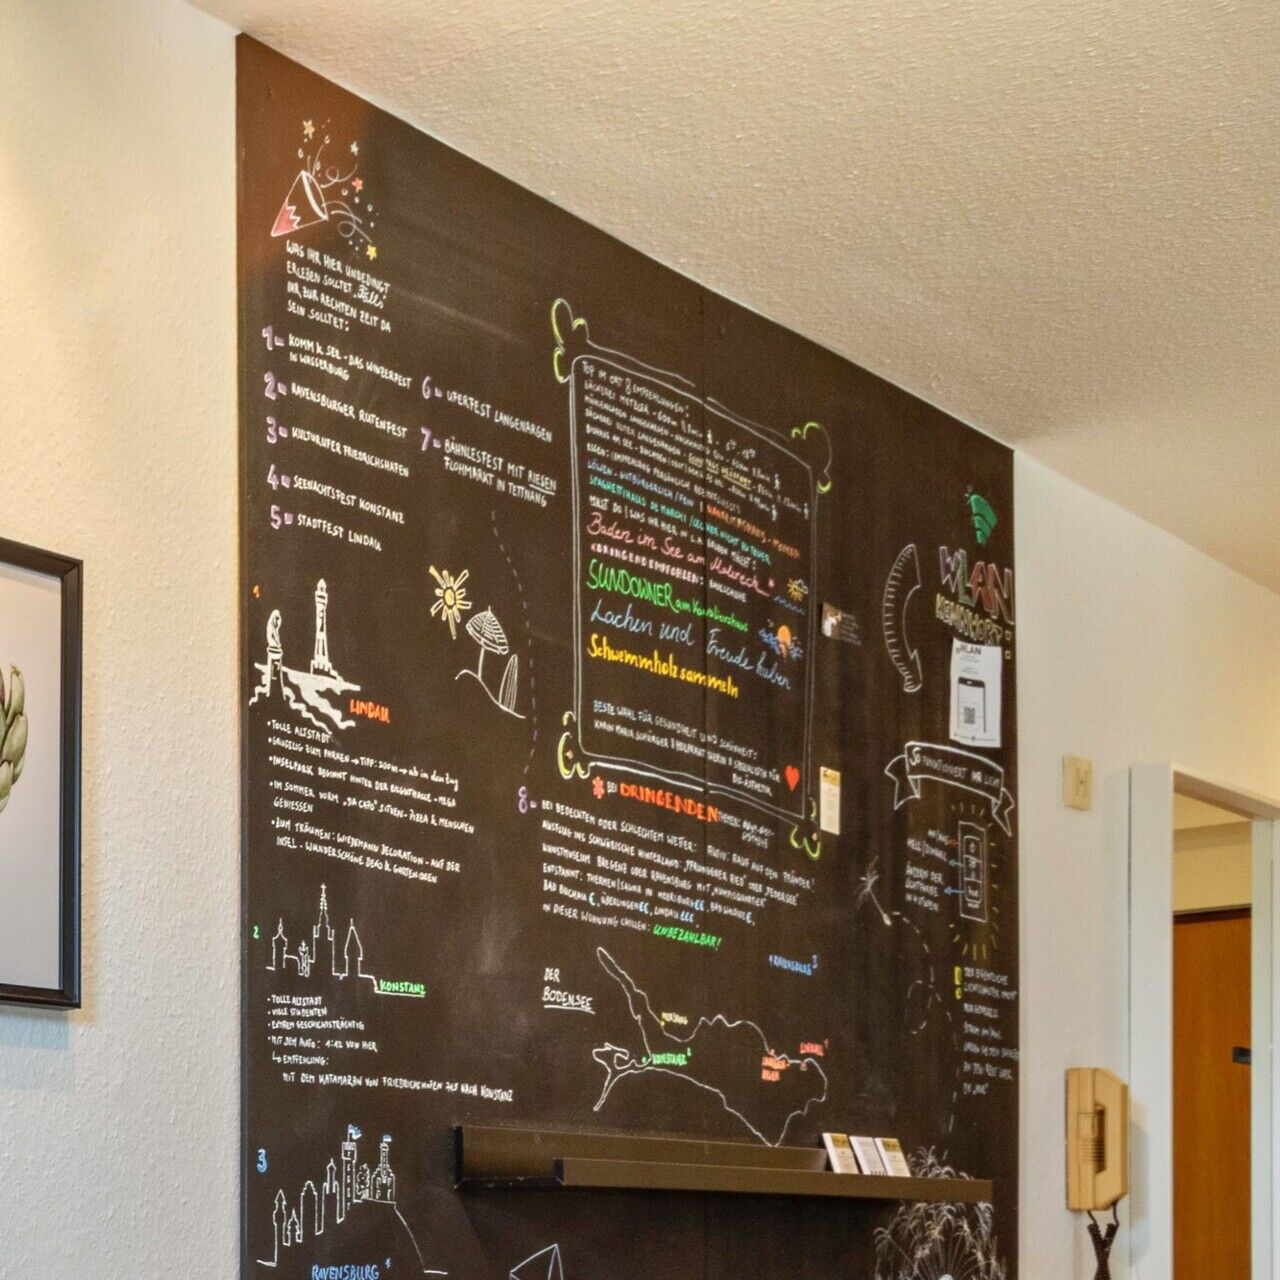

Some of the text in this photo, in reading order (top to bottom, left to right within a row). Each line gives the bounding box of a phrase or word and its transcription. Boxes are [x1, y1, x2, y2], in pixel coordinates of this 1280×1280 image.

[286, 240, 304, 258] WAS
[307, 247, 321, 265] IHR
[323, 254, 342, 273] HIER
[287, 281, 302, 298] IHR
[381, 320, 391, 333] DA
[287, 300, 305, 316] SEIN
[291, 383, 407, 438] RAVENSBURGER RUTENFEST
[507, 462, 525, 478] MIT
[587, 512, 633, 543] Baden
[637, 528, 657, 550] im
[661, 537, 684, 558] See
[587, 559, 679, 613] SUNDOWNER
[940, 546, 1015, 625] WLAN
[659, 622, 693, 646] und
[707, 628, 752, 670] Freude
[620, 783, 719, 823] DRINGENDEN
